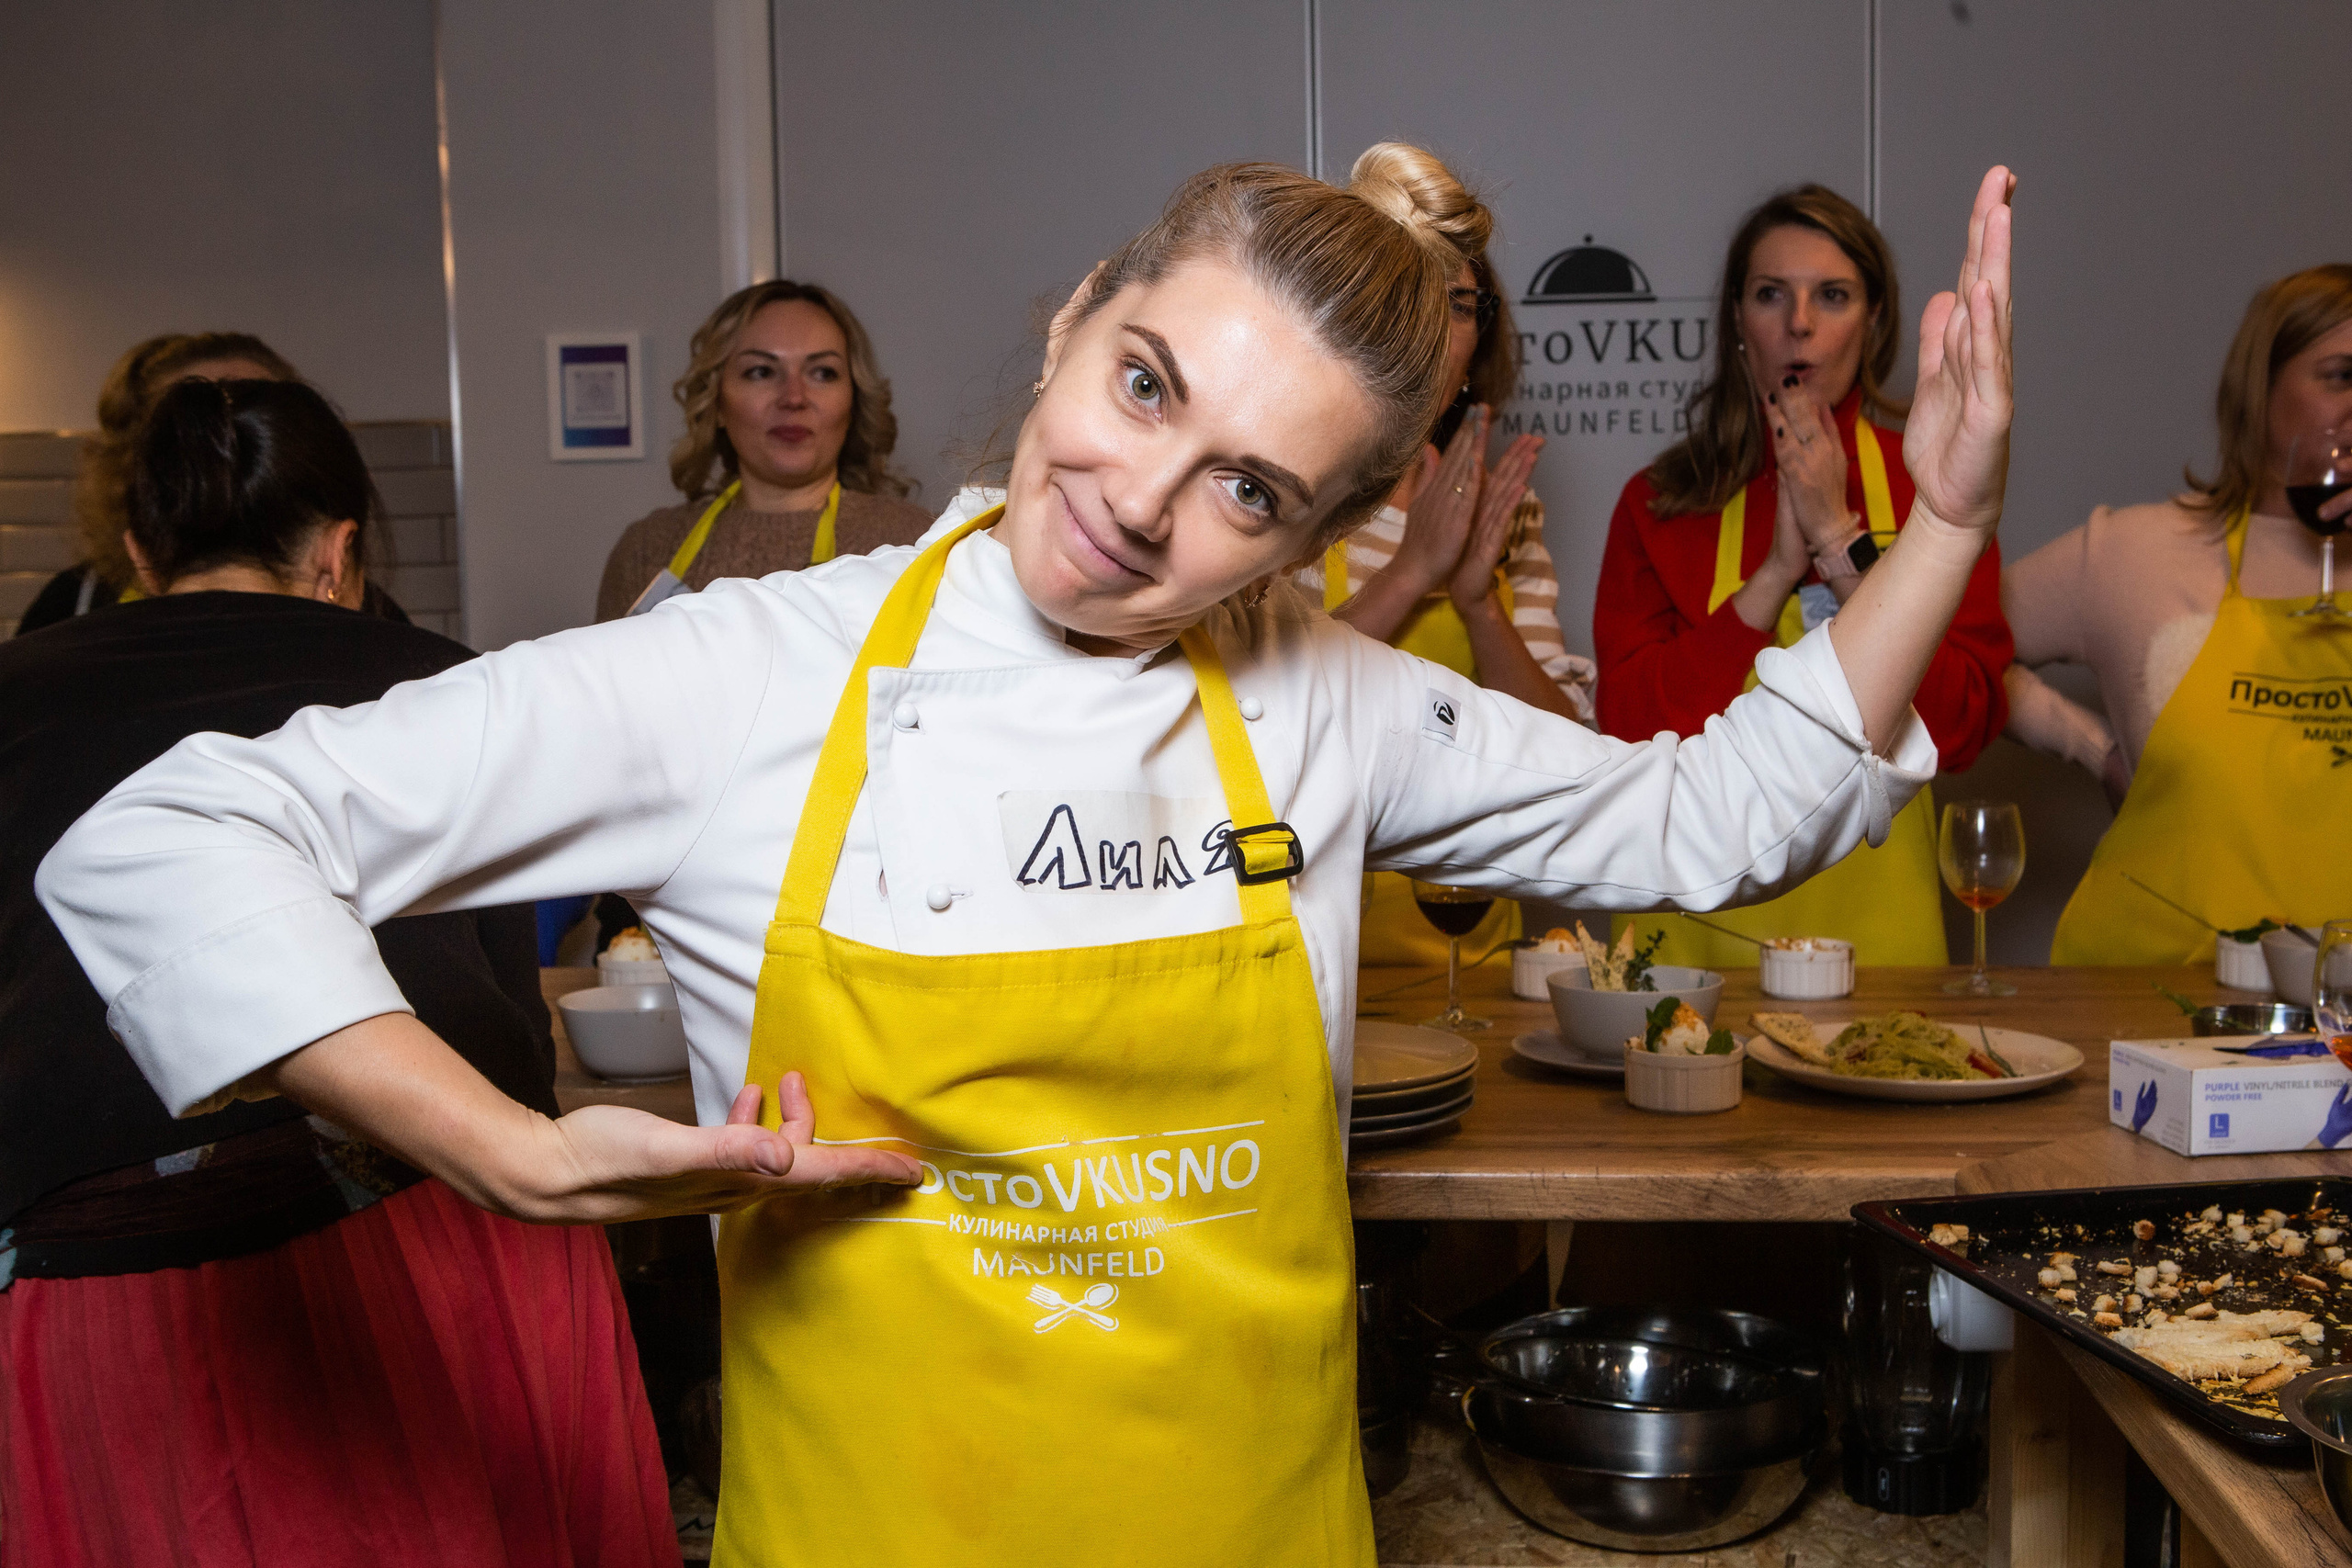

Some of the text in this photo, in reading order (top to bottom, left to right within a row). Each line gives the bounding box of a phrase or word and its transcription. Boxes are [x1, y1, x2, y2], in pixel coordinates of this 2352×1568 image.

[1501, 409, 1690, 436] MAUNFELD
[2205, 1081, 2239, 1092] PURPLE
[2244, 1079, 2311, 1090] VINYL/NITRILE
[2312, 1077, 2343, 1089] BLEND
[2205, 1092, 2262, 1102] POWDER FREE
[2214, 1115, 2223, 1129] L
[949, 1213, 1170, 1244] КУЛИНАРНАЯ СТУДИЯ
[973, 1247, 1165, 1278] MAUNFELD
